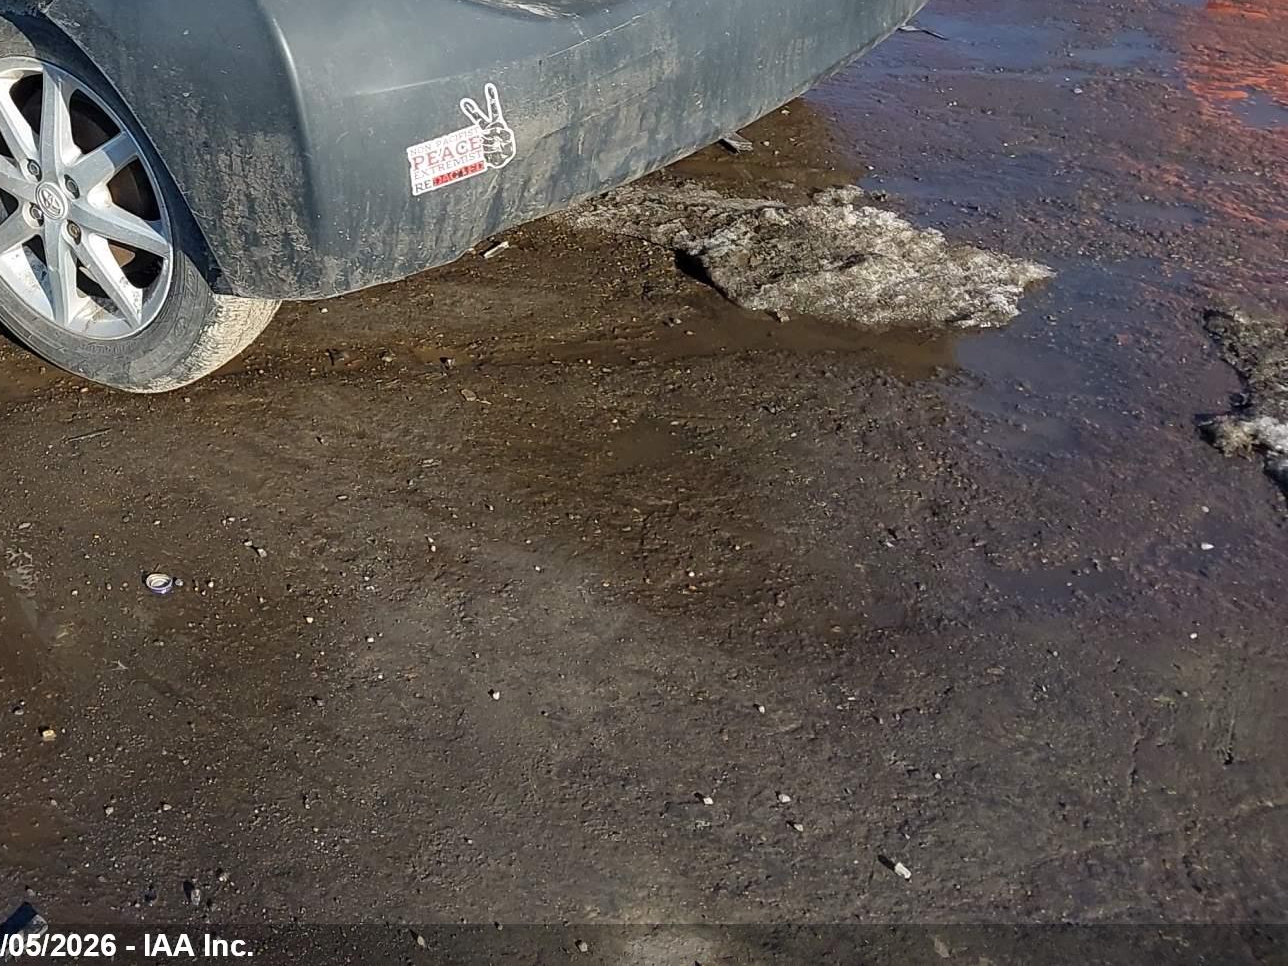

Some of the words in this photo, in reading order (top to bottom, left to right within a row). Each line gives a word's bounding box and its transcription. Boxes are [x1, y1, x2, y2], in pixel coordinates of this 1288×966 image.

[410, 143, 432, 156] NON
[411, 136, 481, 171] PEACE
[414, 149, 482, 180] EXTREMIST
